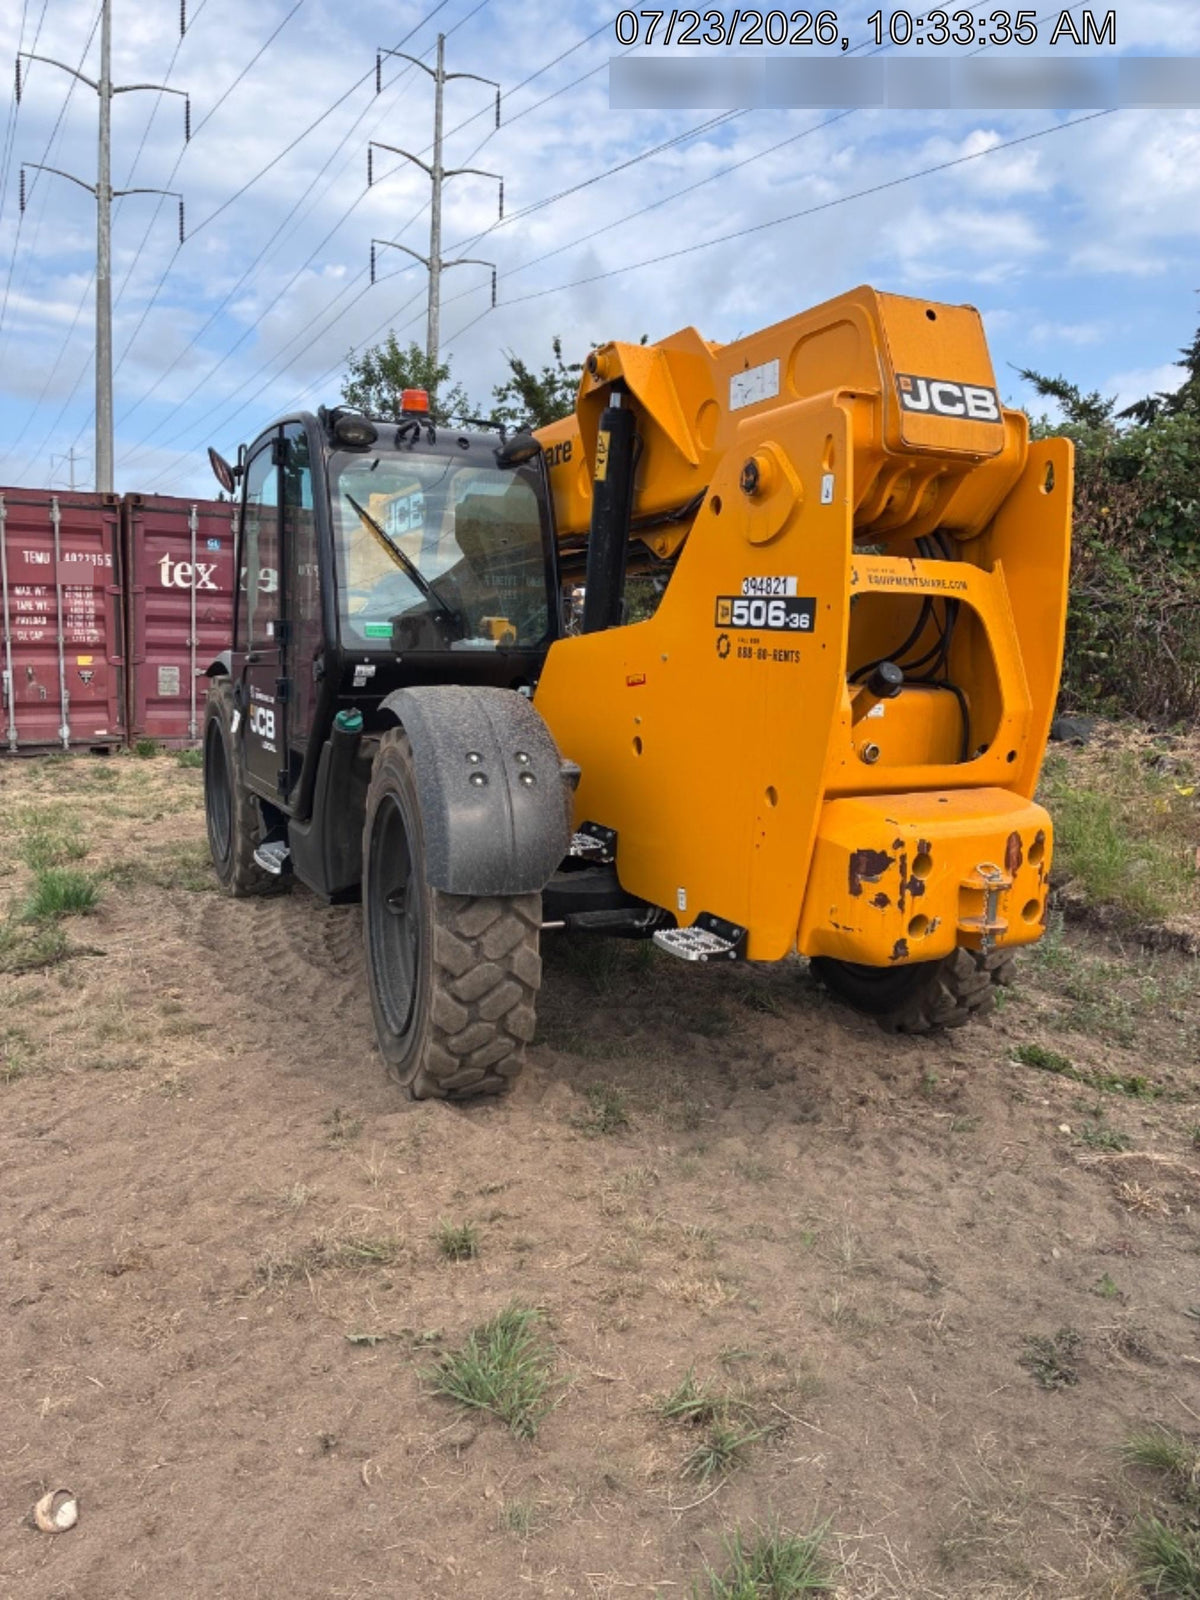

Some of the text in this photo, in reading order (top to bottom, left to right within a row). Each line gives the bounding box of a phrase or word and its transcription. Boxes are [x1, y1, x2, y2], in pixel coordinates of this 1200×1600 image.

[902, 379, 999, 420] JCB
[22, 550, 51, 565] TEMU
[157, 552, 217, 590] tex
[742, 577, 788, 595] 394821
[250, 704, 275, 740] JCB
